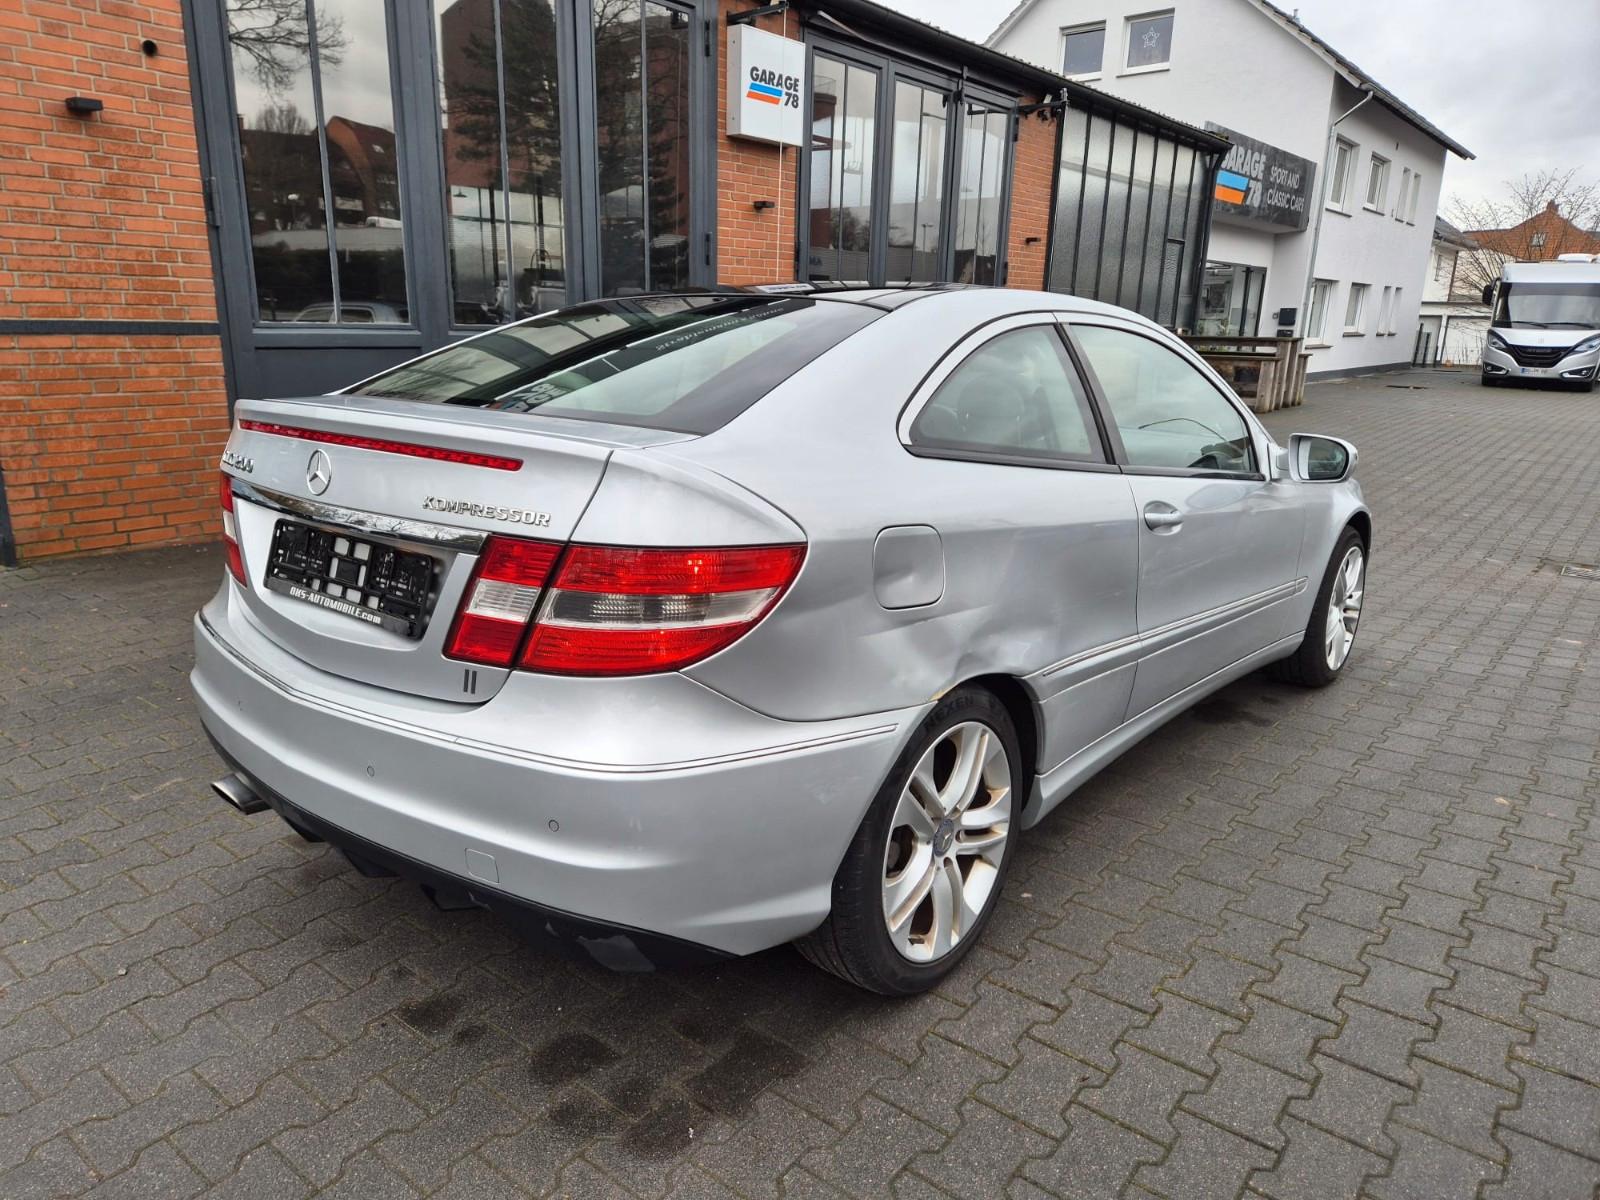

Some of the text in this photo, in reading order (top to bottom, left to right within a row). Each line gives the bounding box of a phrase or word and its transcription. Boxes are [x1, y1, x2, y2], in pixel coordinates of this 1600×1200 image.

[750, 66, 800, 93] GARAGE
[784, 91, 799, 109] 78
[1270, 165, 1300, 189] SPORT AND
[1246, 179, 1263, 208] 78
[1267, 185, 1291, 209] CLASSIC
[423, 496, 551, 527] KOMPRESSOR
